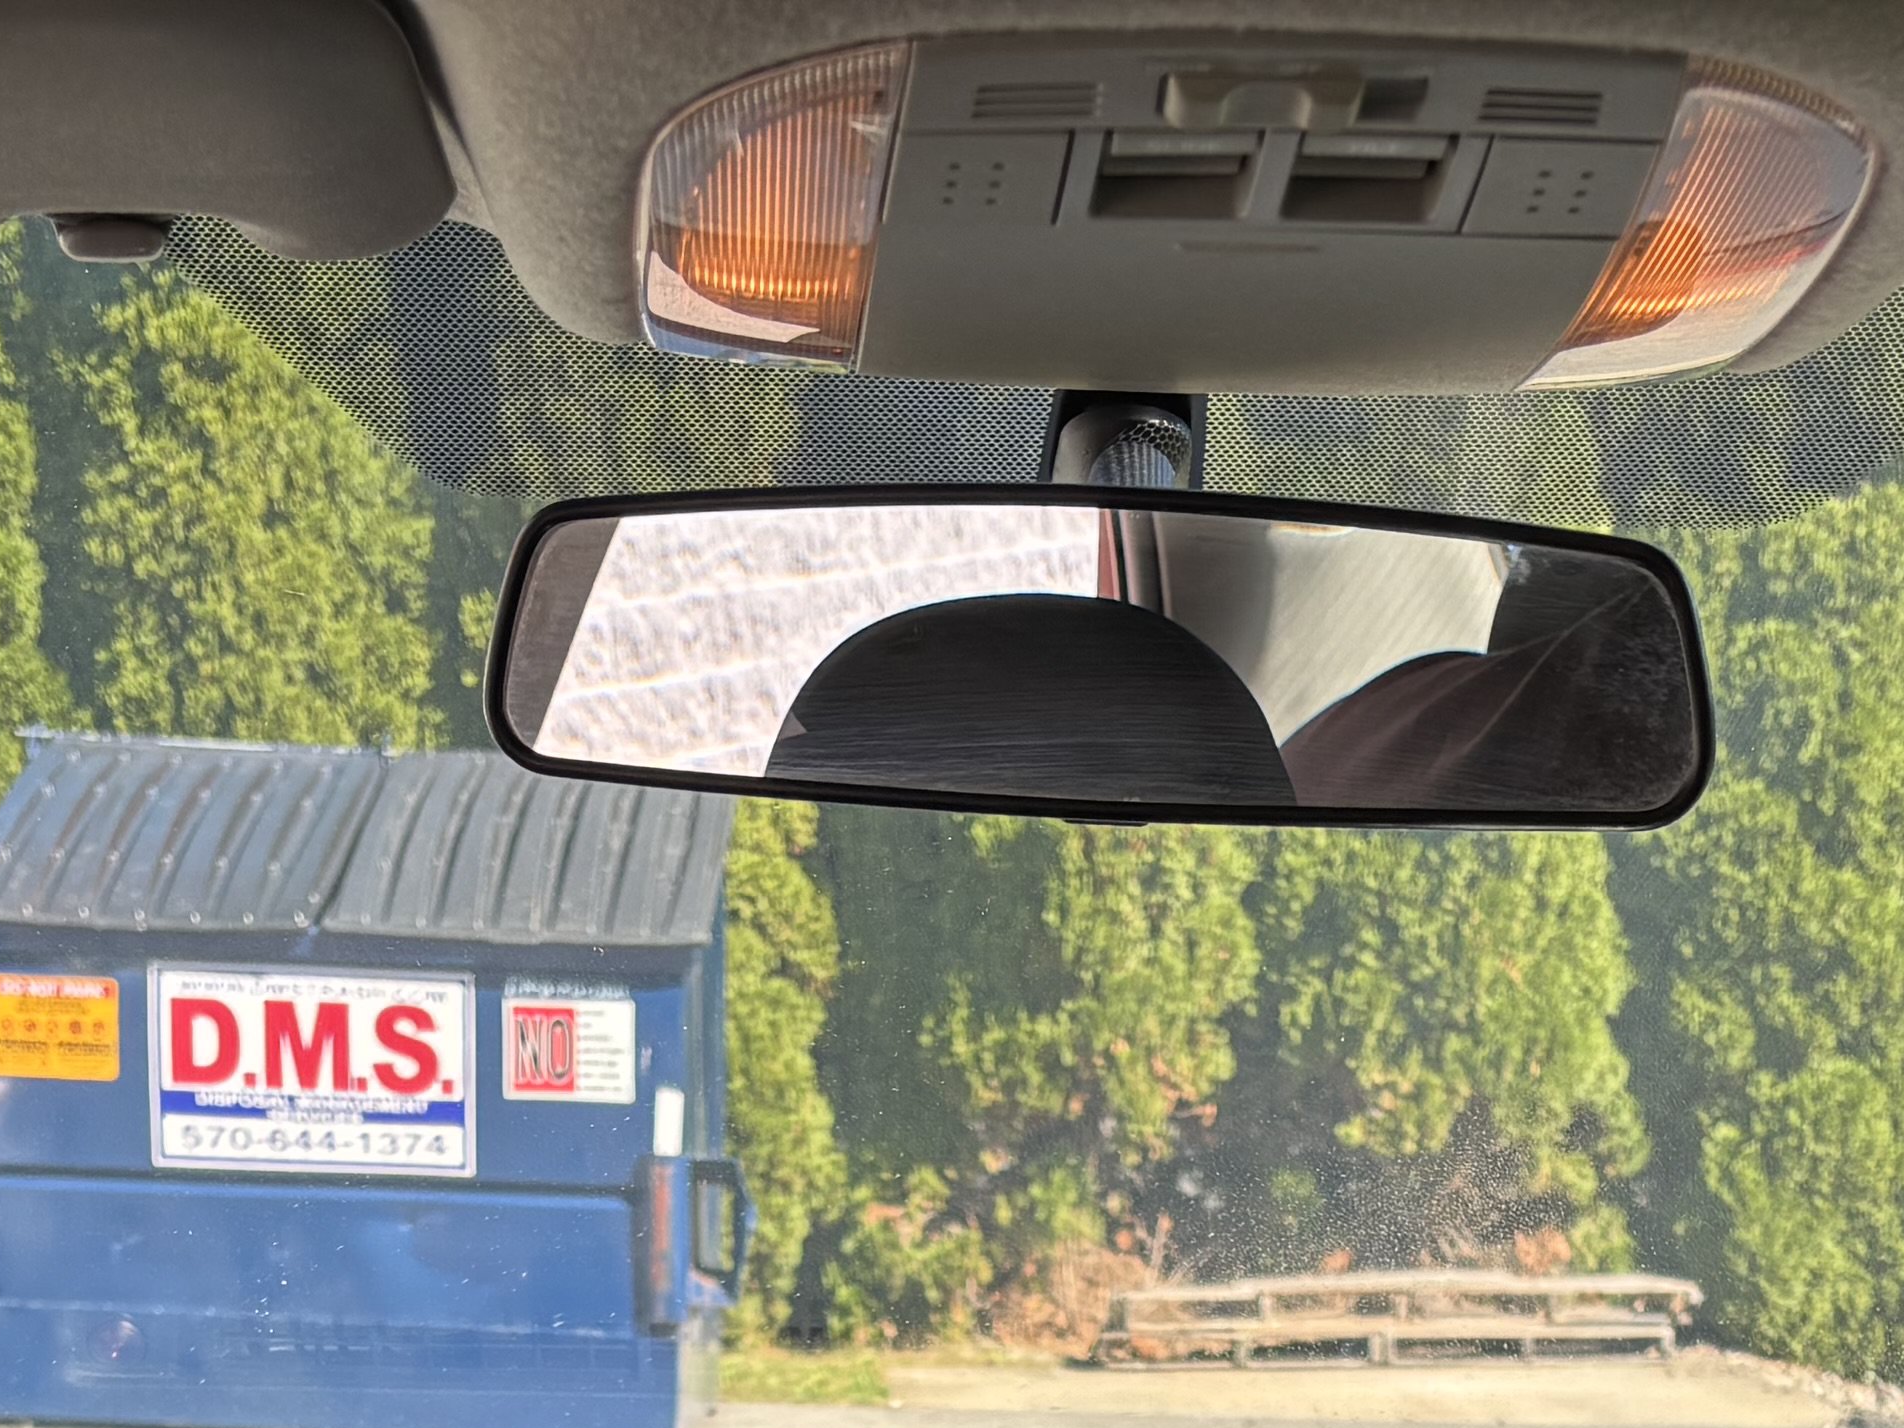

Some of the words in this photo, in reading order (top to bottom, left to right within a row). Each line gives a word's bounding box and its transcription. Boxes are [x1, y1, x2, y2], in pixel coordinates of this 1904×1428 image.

[169, 996, 456, 1096] D.M.S.
[516, 1015, 574, 1084] NO
[180, 1123, 449, 1156] 570-644-1374
